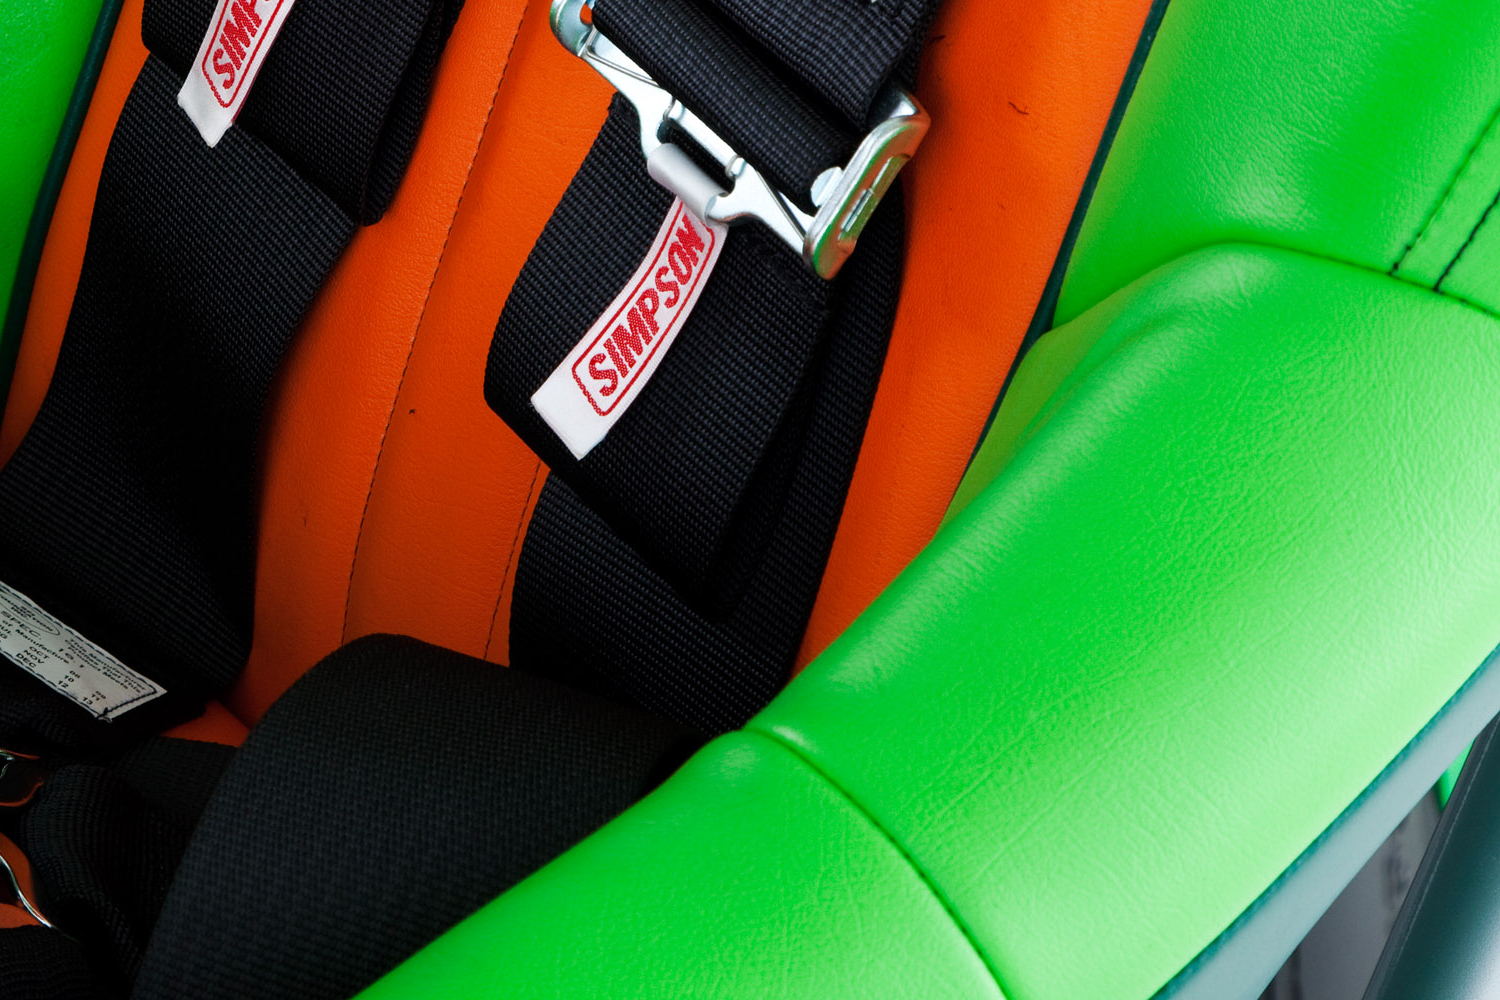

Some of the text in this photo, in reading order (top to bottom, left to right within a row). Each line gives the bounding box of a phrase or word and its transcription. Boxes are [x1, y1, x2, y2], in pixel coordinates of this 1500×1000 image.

[588, 213, 705, 397] SIMPSON
[1, 610, 42, 640] SPEC.
[15, 629, 70, 664] Manufacture
[29, 646, 51, 659] OCT
[16, 653, 37, 668] DEC
[58, 680, 69, 688] 12
[83, 697, 93, 705] 13
[23, 650, 45, 664] NOV
[64, 675, 75, 683] 10
